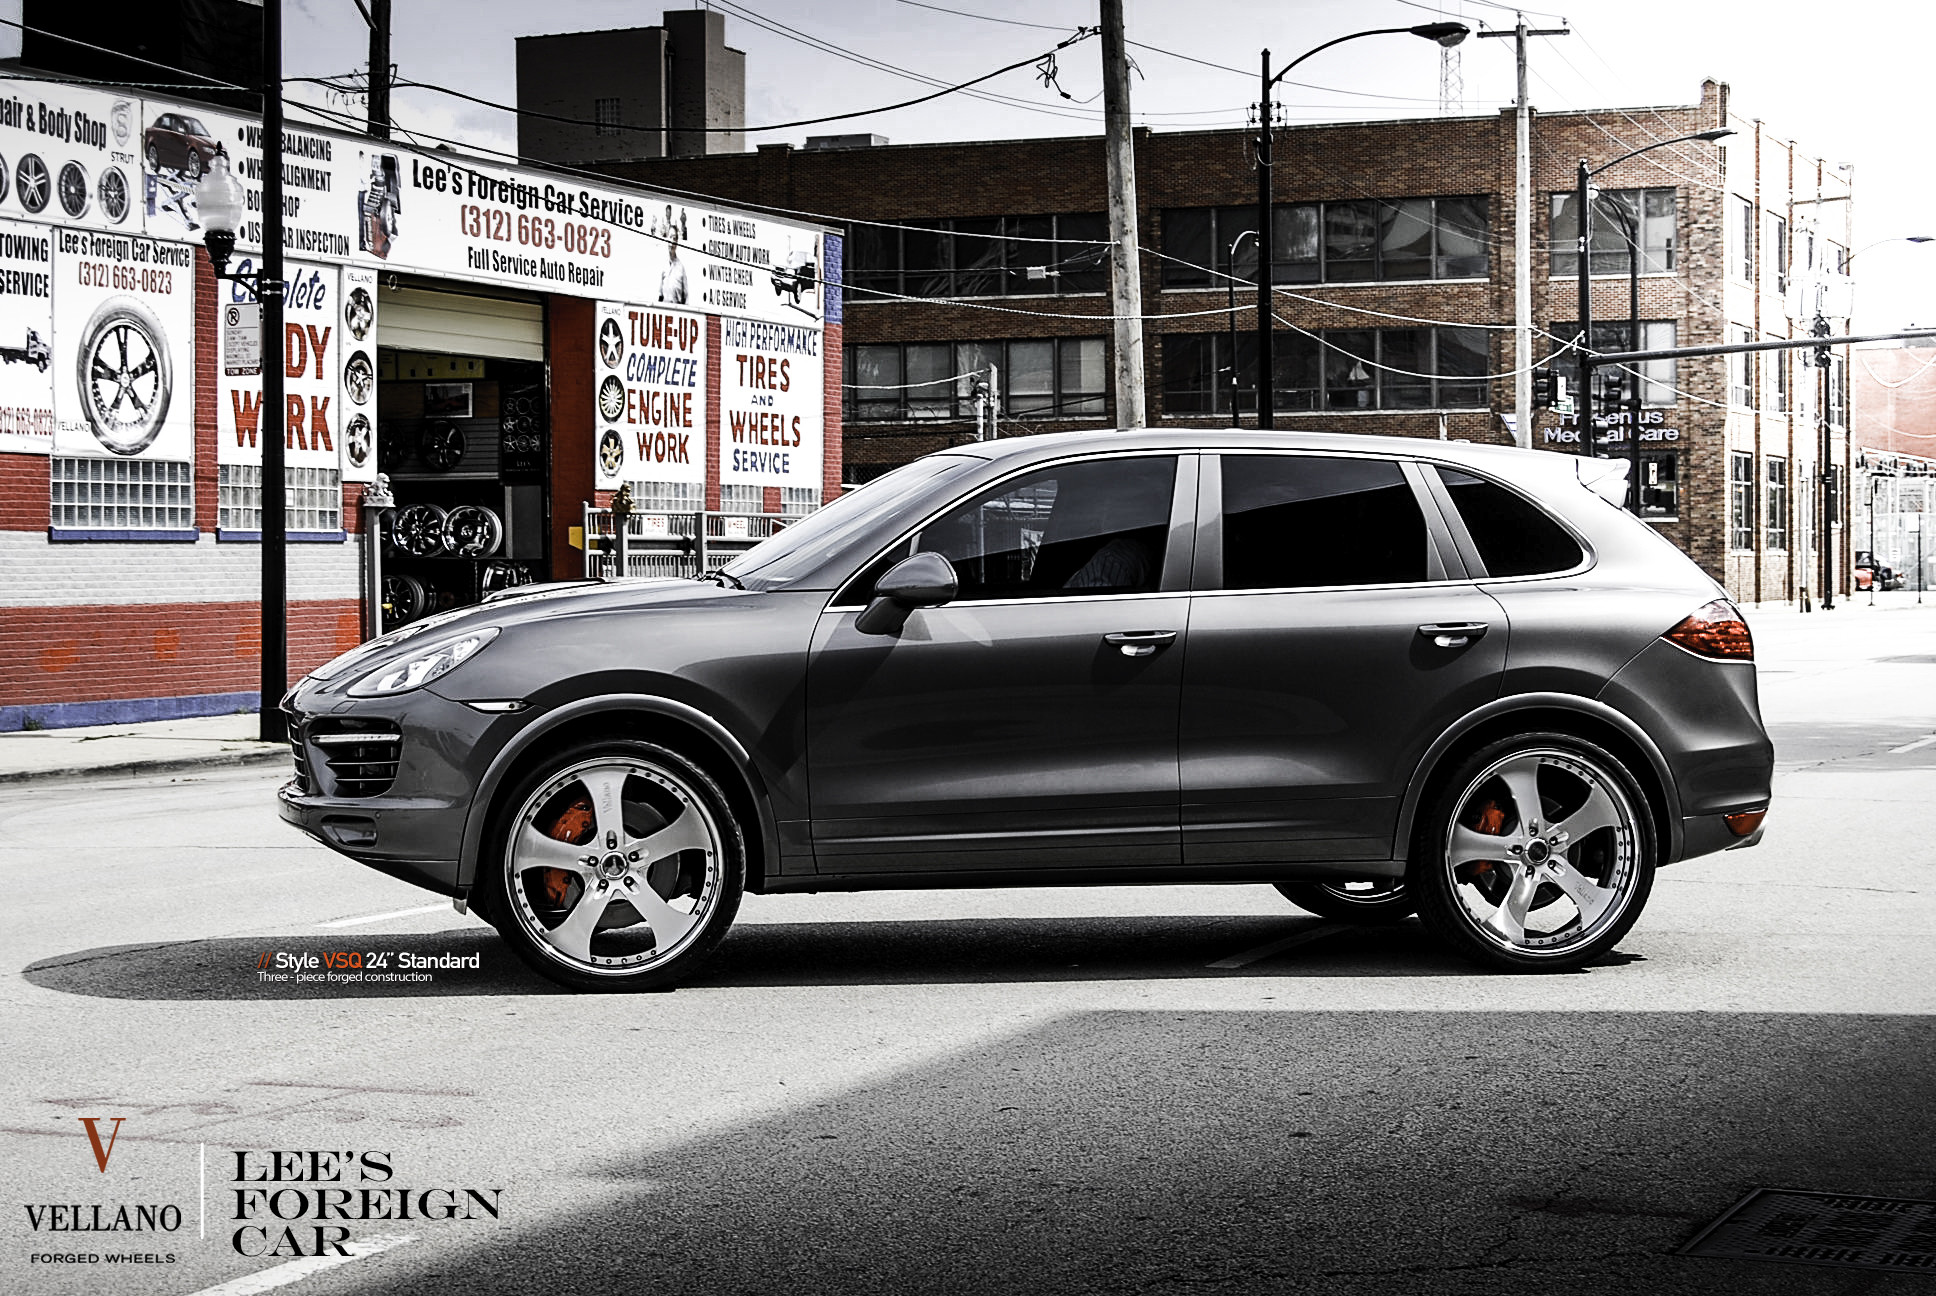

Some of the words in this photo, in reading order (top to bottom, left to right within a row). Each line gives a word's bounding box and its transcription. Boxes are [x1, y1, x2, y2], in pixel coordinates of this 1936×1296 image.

[26, 104, 36, 132] &
[38, 101, 72, 143] Body
[74, 110, 107, 151] Shop
[111, 151, 134, 165] STRUT
[281, 132, 332, 162] BALANCING
[247, 189, 263, 212] BO
[281, 195, 300, 218] HOP
[413, 158, 463, 196] Lee's
[468, 170, 540, 211] Foreign
[544, 184, 575, 216] Car
[579, 190, 644, 228] Service
[281, 226, 294, 249] AR
[296, 228, 350, 256] INSPECTION
[461, 204, 512, 242] (312)
[518, 213, 612, 259] 663-0823
[708, 214, 726, 234] TIRES
[732, 219, 756, 240] WHEELS
[89, 231, 130, 263] Foreign
[131, 238, 150, 263] Car
[152, 240, 190, 268] Service
[708, 239, 735, 260] CUSTOM
[735, 243, 752, 263] AUTO
[752, 247, 770, 266] WORK
[0, 268, 50, 298] SERVICE
[78, 261, 109, 288] (312)
[112, 265, 172, 295] 663-0823
[347, 272, 374, 284] VELLANO
[468, 246, 490, 271] Full
[492, 249, 538, 278] Service
[540, 257, 566, 282] Auto
[568, 262, 604, 288] Repair
[708, 263, 733, 284] WINTER
[733, 268, 753, 287] CHECK
[709, 288, 721, 306] A/C
[721, 290, 747, 310] SERVICE
[628, 310, 699, 354] TUNE-UP
[725, 319, 748, 348] HIGH
[749, 322, 818, 357] PERFORMANCE
[285, 322, 332, 380] DY
[241, 367, 258, 375] ZONE
[626, 352, 698, 388] COMPLETE
[736, 354, 791, 392] TIRES
[626, 388, 693, 428] ENGINE
[751, 394, 774, 407] AND
[231, 389, 334, 452] WRK
[729, 409, 801, 448] WHEELS
[636, 430, 690, 465] WORK
[732, 448, 790, 474] SERVICE
